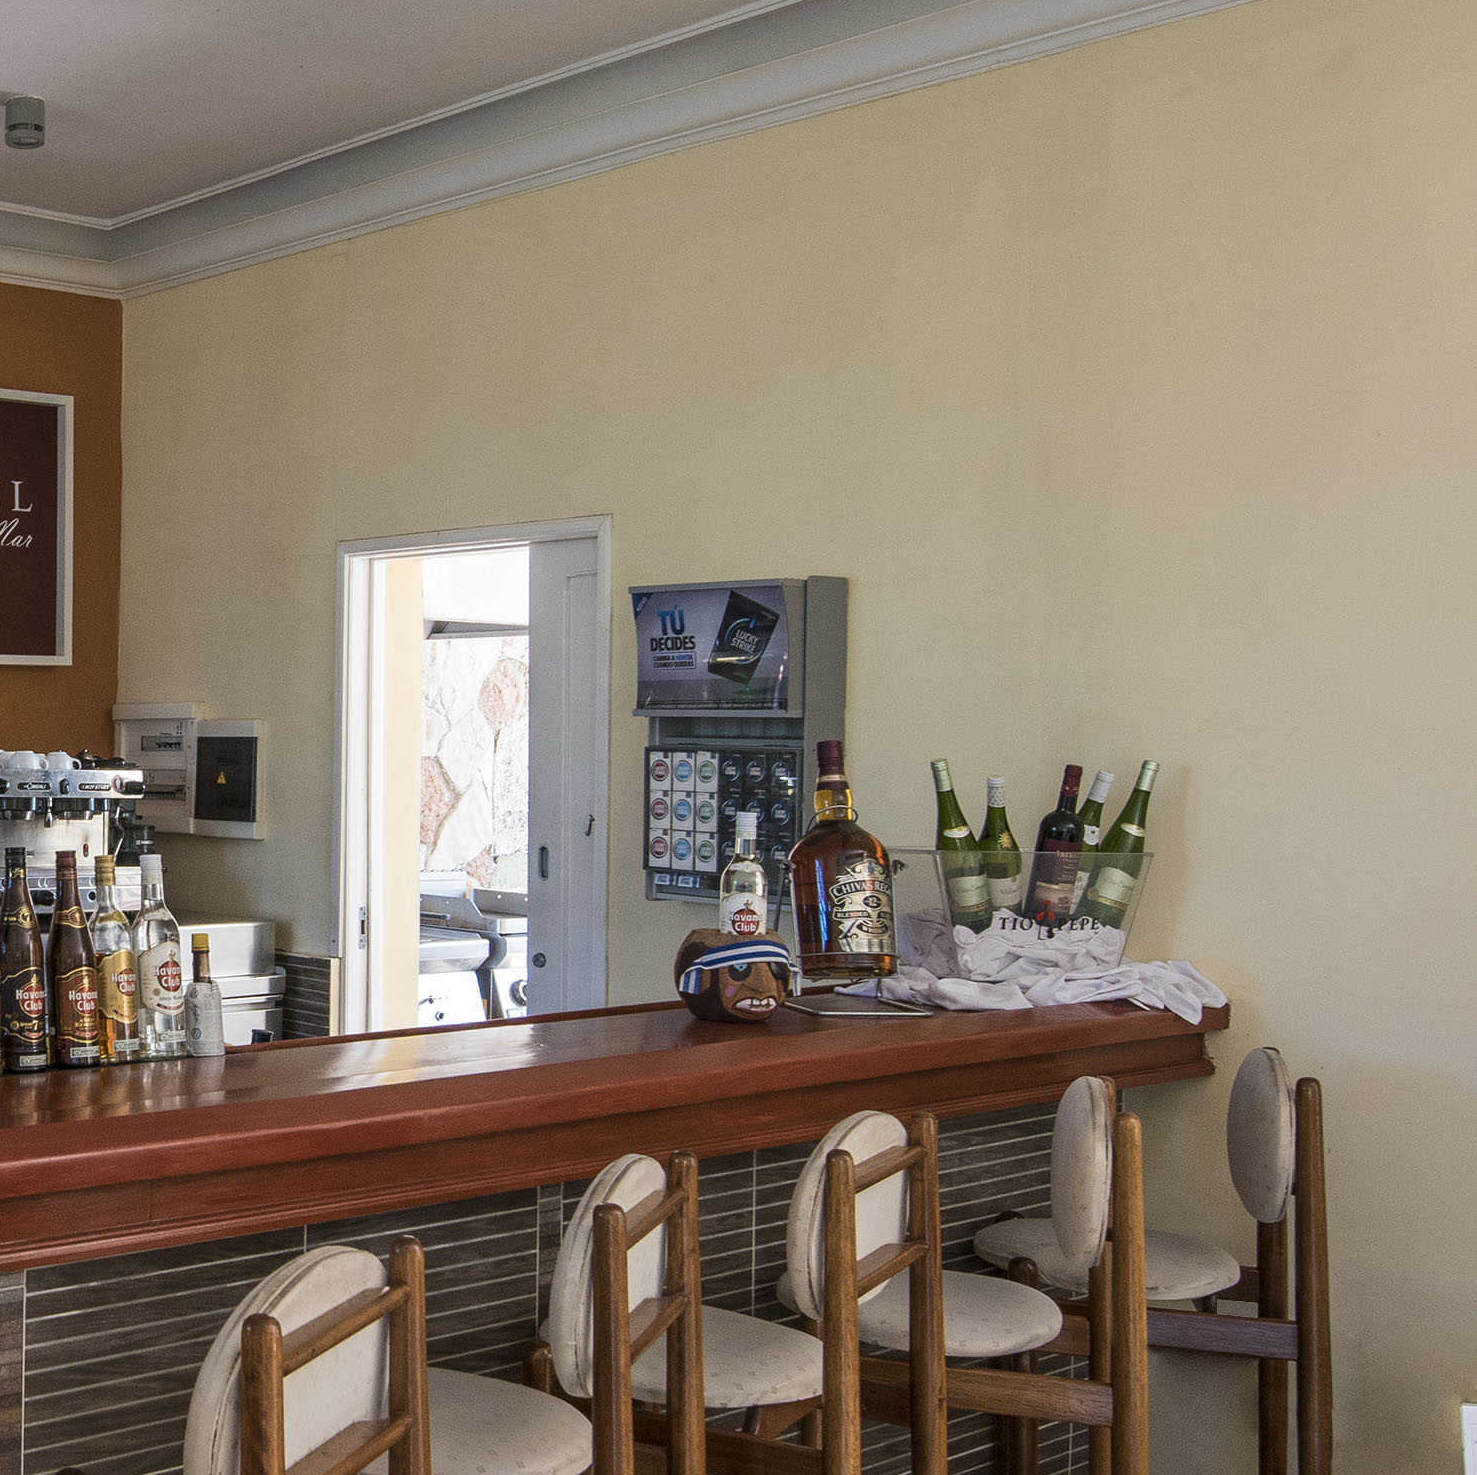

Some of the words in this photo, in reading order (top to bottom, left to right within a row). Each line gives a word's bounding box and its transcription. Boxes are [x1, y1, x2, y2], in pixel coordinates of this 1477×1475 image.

[656, 604, 686, 636] TÚ
[650, 635, 696, 652] DECIDES
[735, 629, 760, 646] LUCKY
[730, 637, 757, 654] STRIKE
[833, 879, 875, 897] CHIVAS
[867, 896, 879, 908] 12
[837, 910, 868, 919] BLENDED
[734, 922, 756, 932] Club
[998, 917, 1034, 931] TIO
[1058, 917, 1101, 931] PEPE
[119, 981, 136, 993] Club
[161, 975, 181, 988] Club
[24, 1000, 43, 1012] Club
[76, 1000, 96, 1012] Club
[32, 1019, 39, 1031] 7
